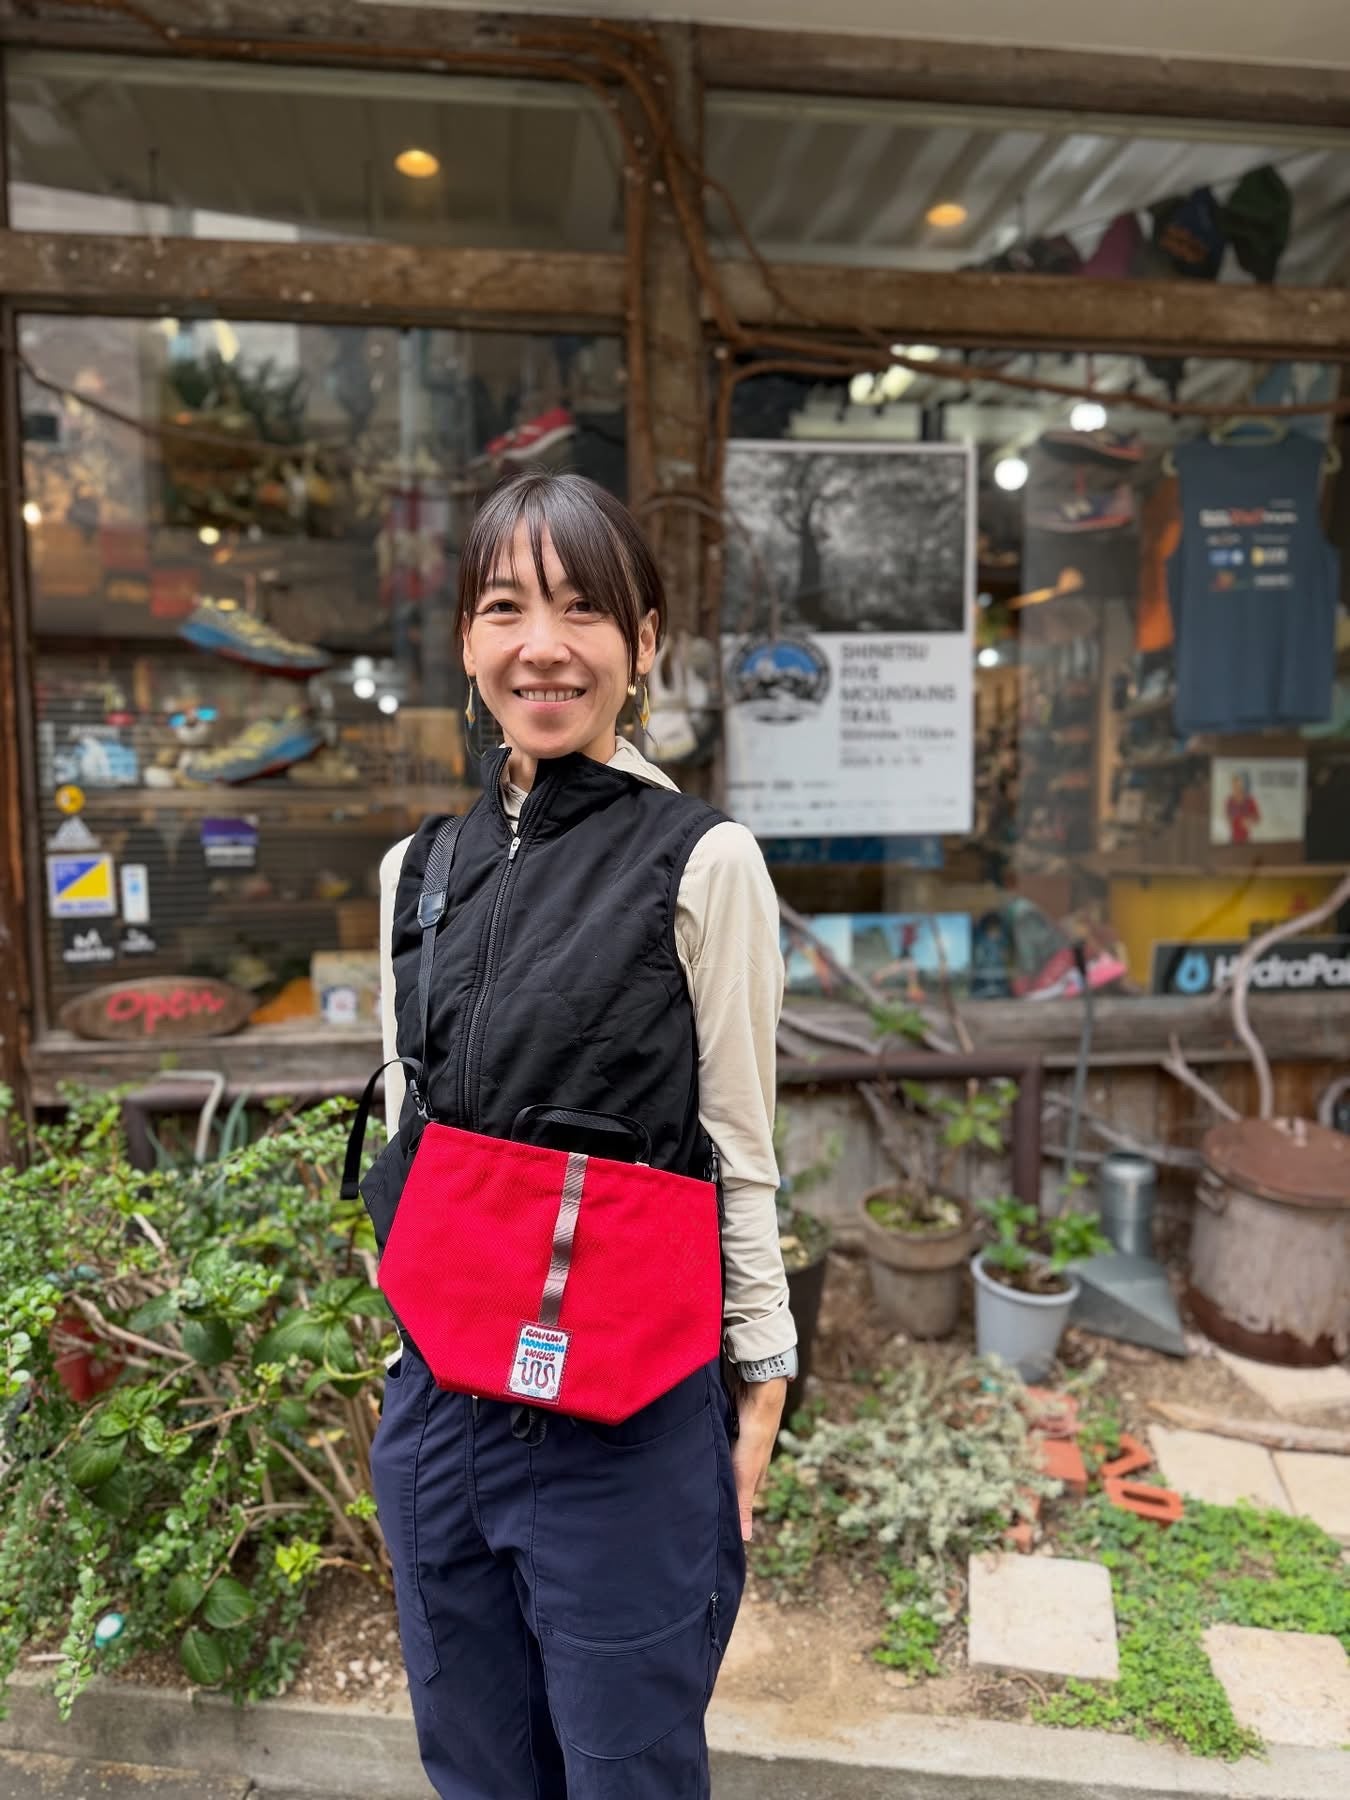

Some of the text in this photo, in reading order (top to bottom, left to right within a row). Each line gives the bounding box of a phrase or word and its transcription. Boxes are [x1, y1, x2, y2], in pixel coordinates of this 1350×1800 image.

[841, 685, 955, 702] MOUNTAINS
[841, 708, 891, 723] TRAIL
[106, 988, 225, 1034] Open
